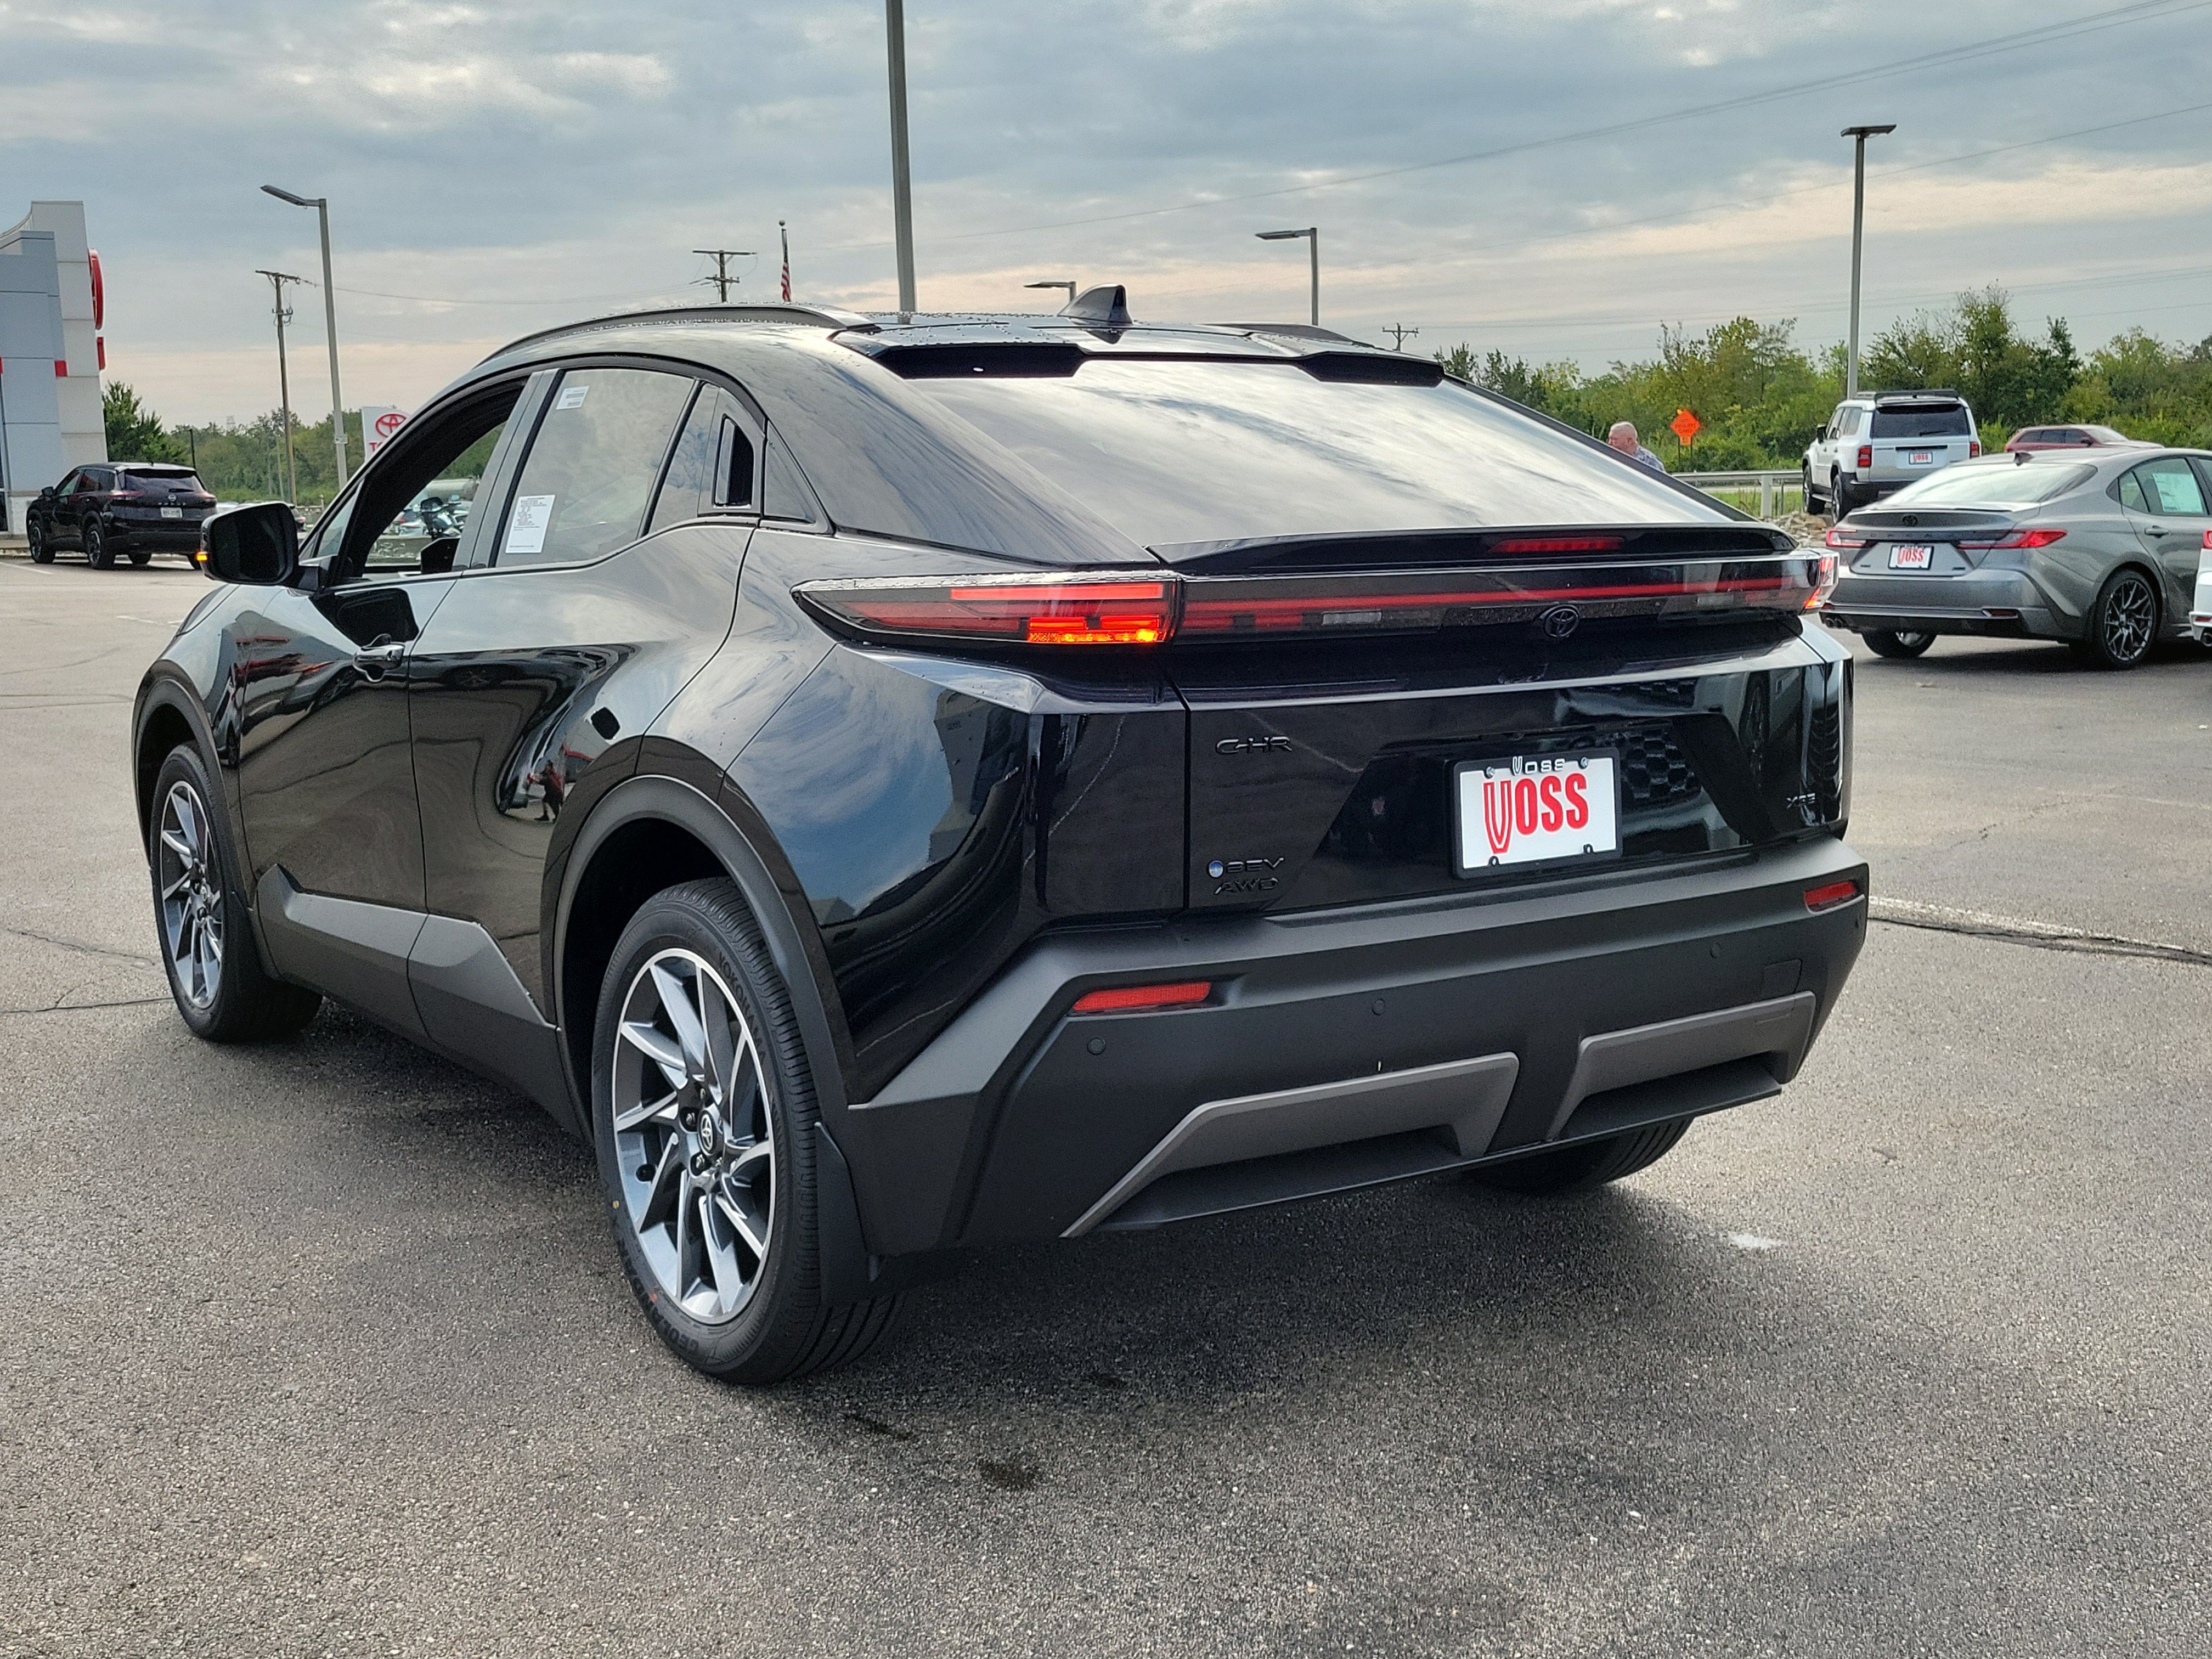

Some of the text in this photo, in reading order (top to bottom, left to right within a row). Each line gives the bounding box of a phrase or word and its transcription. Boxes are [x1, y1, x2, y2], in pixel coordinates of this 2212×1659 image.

[1897, 549, 1925, 565] VOSS
[1216, 736, 1293, 754] C-HR
[1483, 772, 1589, 855] VOSS
[1227, 857, 1285, 873] BEV
[1214, 877, 1279, 895] AWD
[717, 950, 768, 1065] YOKOHAMA
